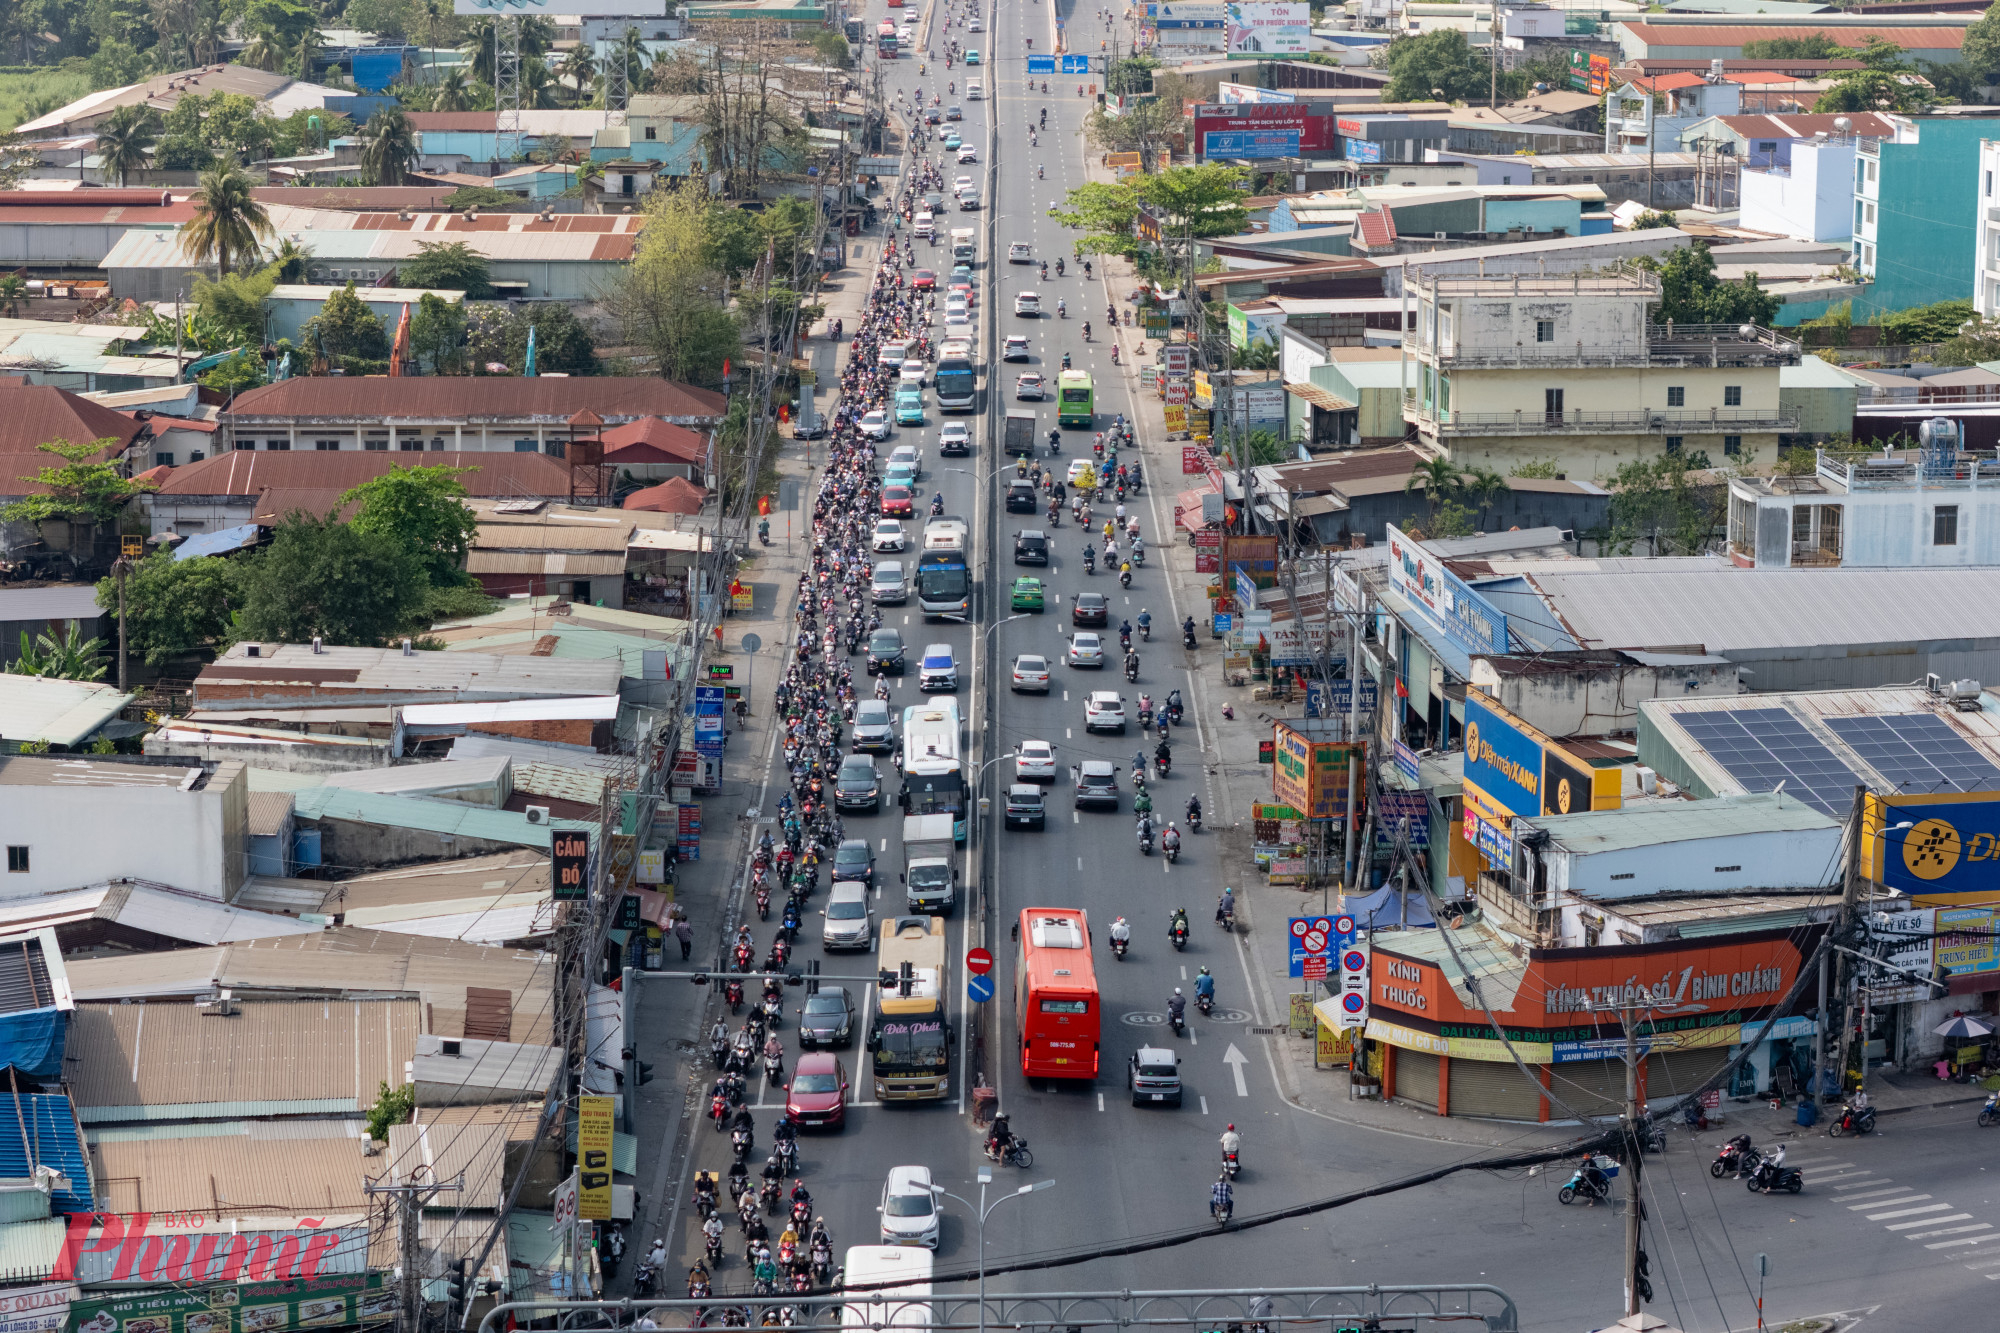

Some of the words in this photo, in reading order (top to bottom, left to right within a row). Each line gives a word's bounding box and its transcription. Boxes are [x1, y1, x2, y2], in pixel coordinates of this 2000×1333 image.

[1270, 7, 1289, 15] TÔN
[1249, 104, 1308, 117] MAXXIS
[1338, 118, 1361, 132] MAXXIS
[1169, 362, 1186, 370] NGHỈ
[1169, 385, 1185, 394] NHÀ
[1165, 409, 1174, 423] TRÀ
[1391, 540, 1401, 562] Thép
[1458, 598, 1470, 624] CHÍ
[1470, 608, 1493, 645] THÀNH
[1273, 629, 1298, 639] TÂN
[1479, 739, 1497, 768] Điện
[646, 866, 653, 876] Y
[624, 919, 637, 927] CÀO
[1296, 924, 1304, 933] 60
[1319, 922, 1327, 930] 60
[1341, 921, 1349, 929] 60
[1898, 919, 1907, 930] VÉ
[1911, 914, 1922, 929] SỐ
[1938, 924, 1961, 949] NHÀ
[1902, 958, 1913, 967] CÁC
[1939, 951, 1966, 964] TRUNG
[1968, 947, 1988, 960] HIẾU
[1388, 960, 1421, 983] KÍNH
[1546, 983, 1586, 1014] KÍNH
[1592, 974, 1644, 1004] THUỐC
[1652, 970, 1672, 999] SỐ
[1673, 966, 1694, 1002] 1
[1692, 970, 1727, 1000] BÌNH
[1732, 963, 1782, 996] CHÁNH
[1381, 984, 1427, 1010] THUỐC
[884, 1023, 909, 1034] Đức
[910, 1021, 941, 1034] Phát
[1678, 1018, 1696, 1030] GIA
[1700, 1014, 1724, 1028] KÍNH
[1391, 1025, 1413, 1046] MÁT
[1416, 1033, 1430, 1049] CÓ
[1433, 1037, 1449, 1054] ĐỘ
[1440, 1027, 1463, 1038] ĐẠI
[1466, 1026, 1480, 1038] LÝ
[1485, 1027, 1520, 1041] HÀNG
[1524, 1028, 1549, 1043] ĐẦU
[1554, 1028, 1575, 1040] GIÁ
[1319, 1036, 1333, 1054] TRÀ
[1554, 1043, 1577, 1051] TRÒNG
[1450, 1050, 1471, 1058] CAO
[1530, 1054, 1551, 1063] 100K
[1562, 1053, 1581, 1061] XANH
[1583, 1050, 1601, 1060] NHẬT
[305, 1276, 368, 1292] Barbie
[114, 1302, 133, 1311] HỦ
[137, 1298, 170, 1308] TIẾU
[175, 1294, 207, 1308] MỰC
